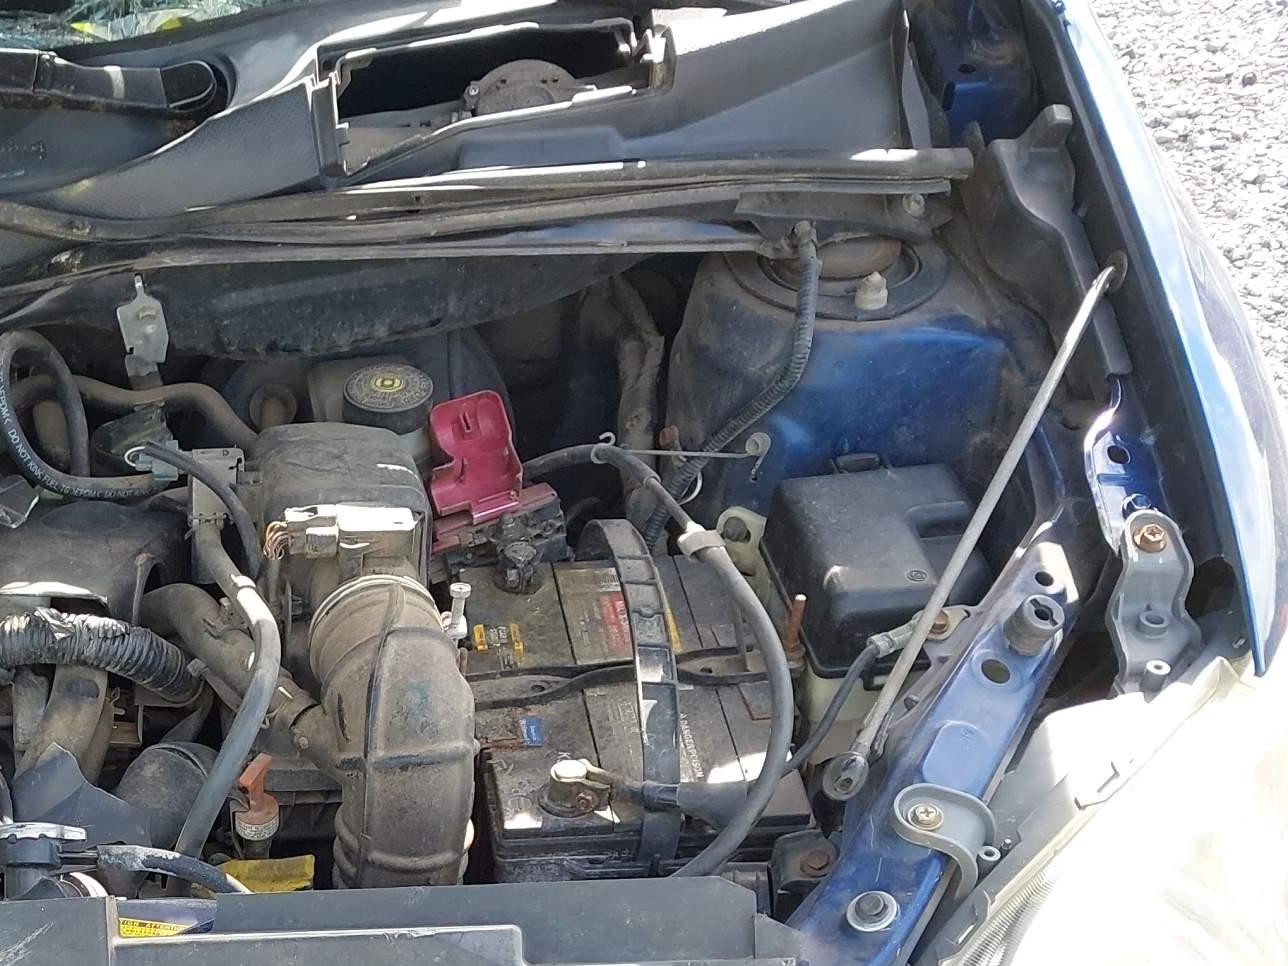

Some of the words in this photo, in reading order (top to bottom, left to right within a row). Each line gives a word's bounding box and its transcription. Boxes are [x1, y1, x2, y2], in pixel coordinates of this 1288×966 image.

[8, 429, 20, 444] DO
[16, 444, 31, 462] NOT
[42, 474, 58, 490] FUEL
